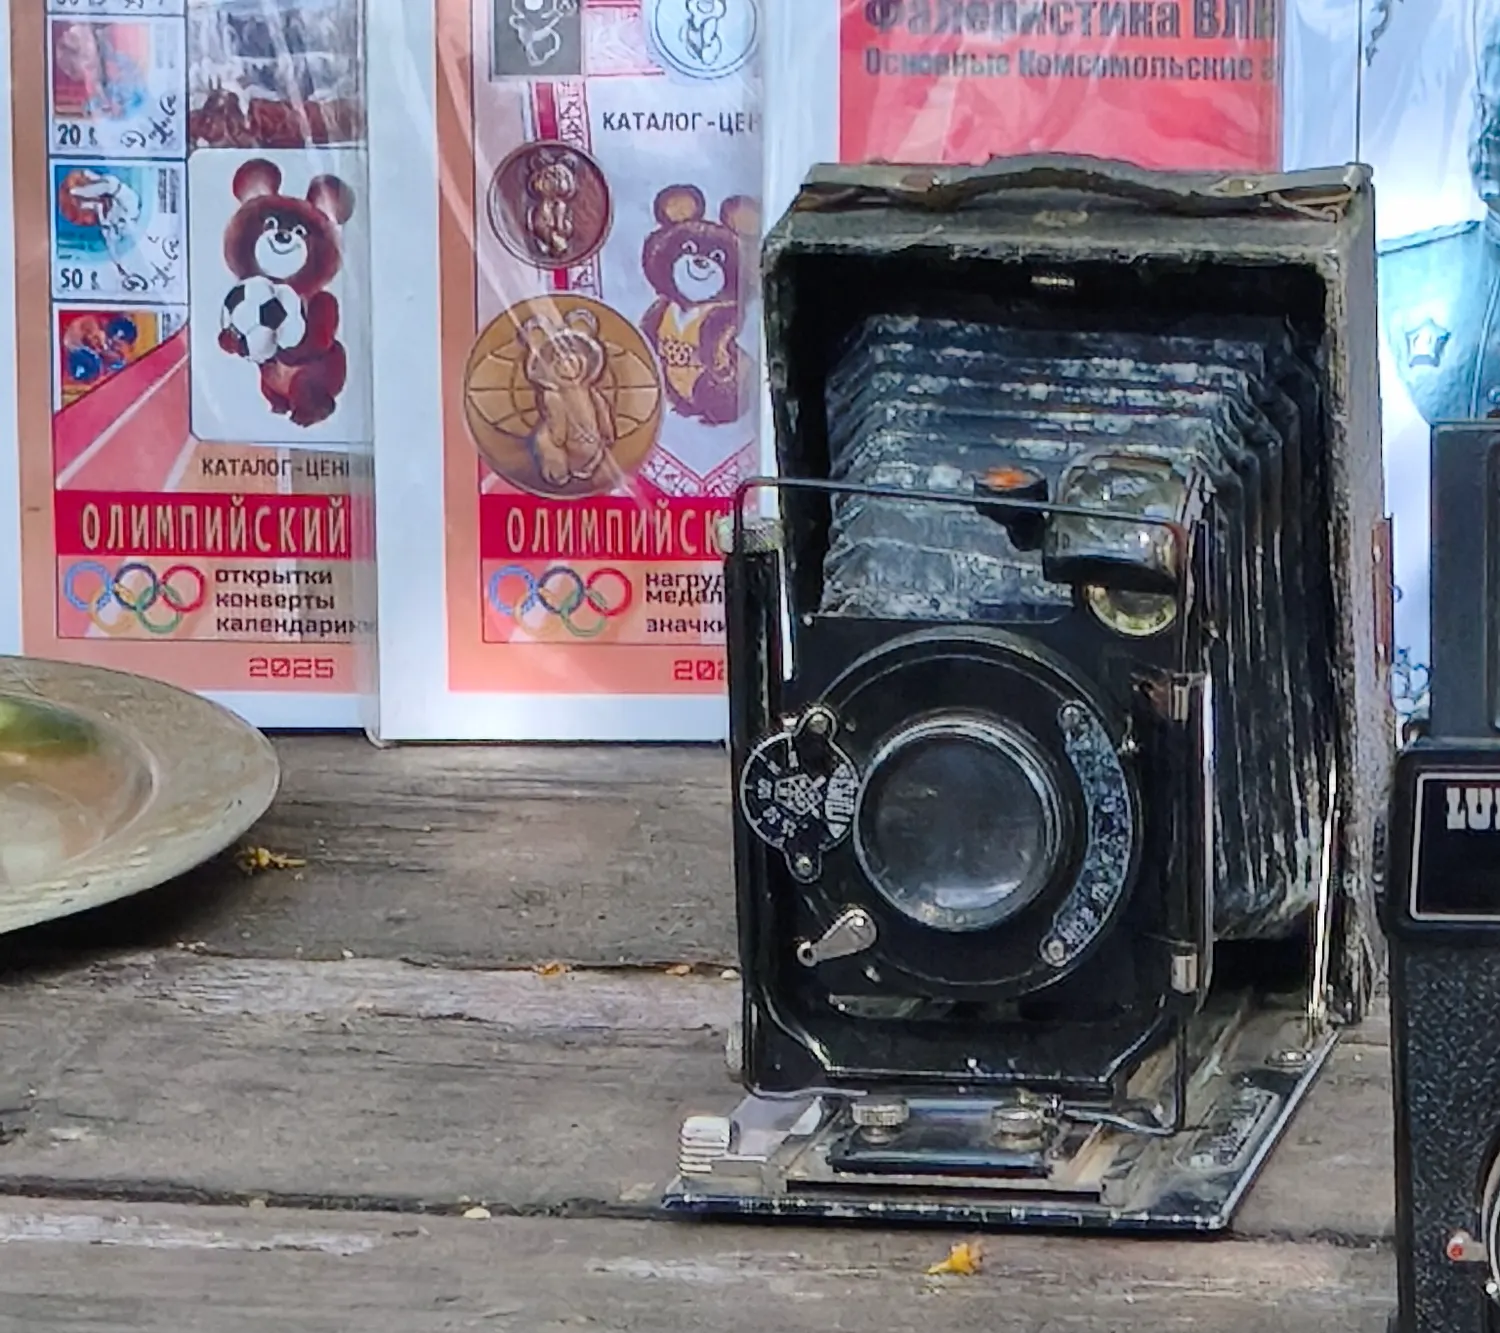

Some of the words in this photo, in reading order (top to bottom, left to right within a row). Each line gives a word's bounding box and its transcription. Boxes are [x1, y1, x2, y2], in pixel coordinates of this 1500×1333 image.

[82, 494, 347, 553] ОЛИМПИЙСКИЙ
[215, 569, 332, 587] открытки
[216, 594, 335, 611] конверты
[249, 657, 334, 678] 2025
